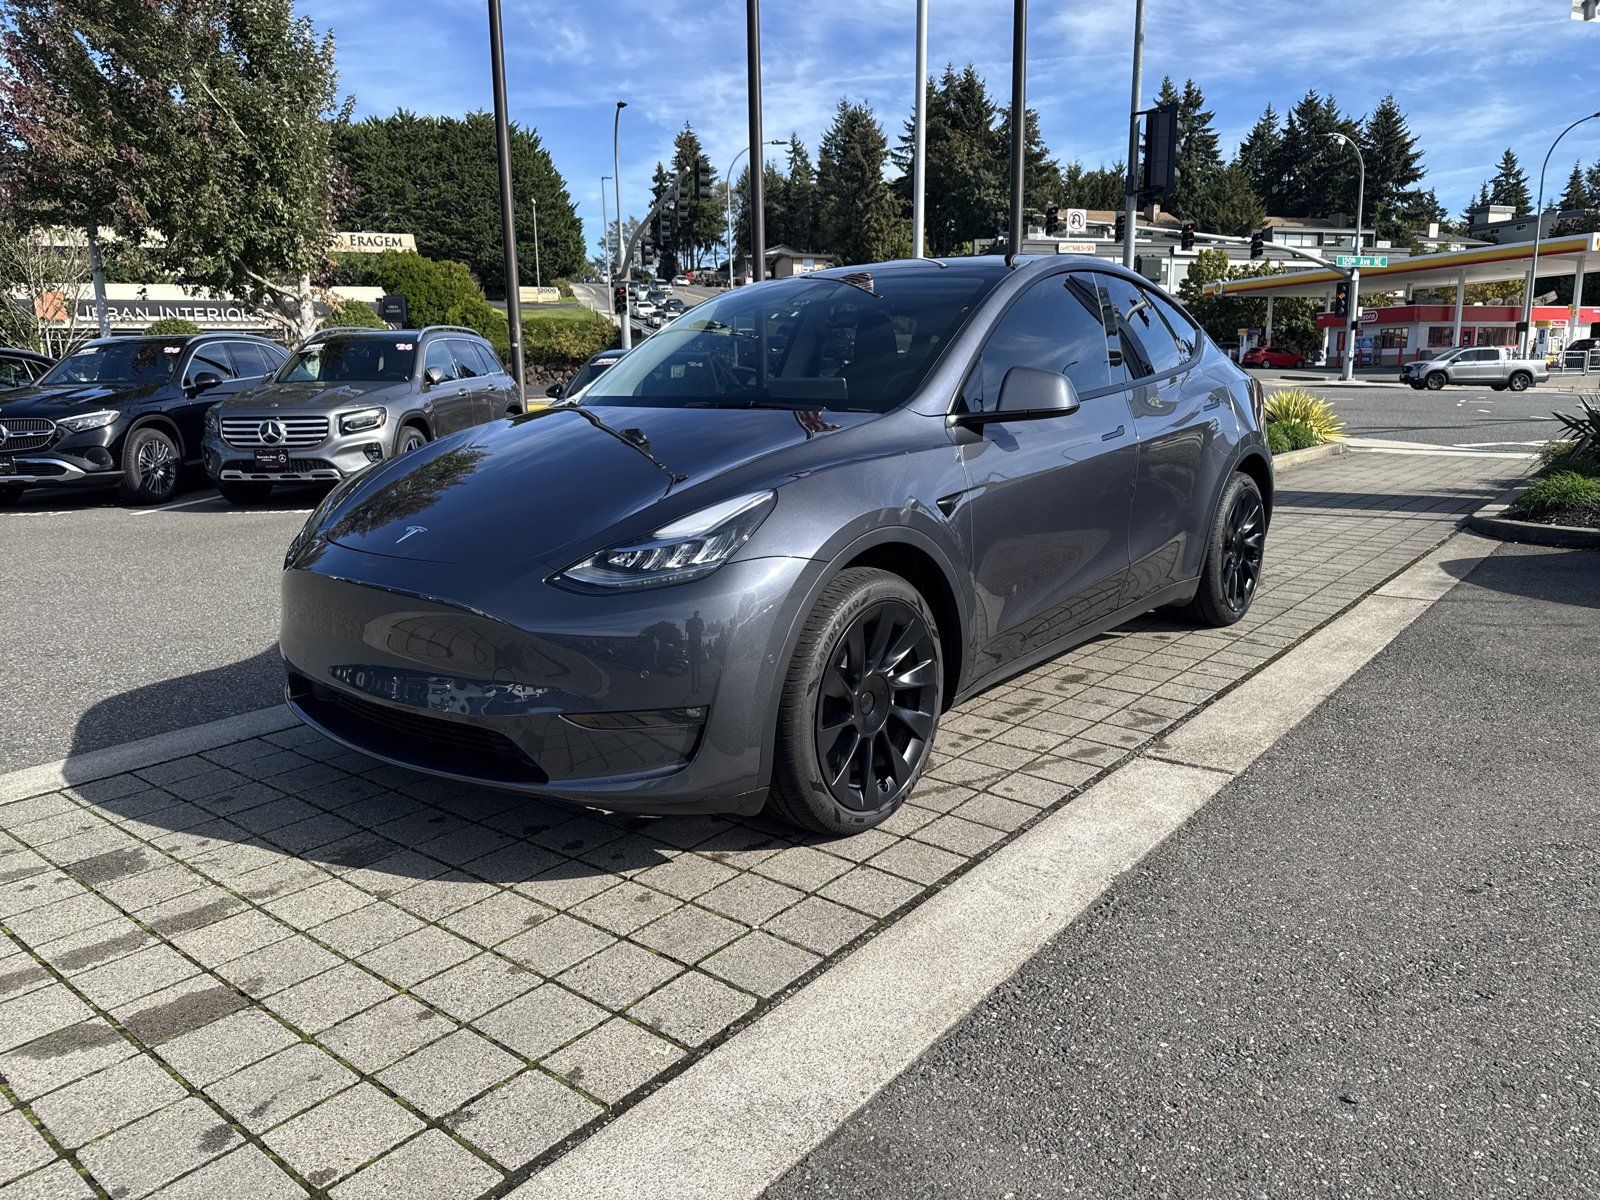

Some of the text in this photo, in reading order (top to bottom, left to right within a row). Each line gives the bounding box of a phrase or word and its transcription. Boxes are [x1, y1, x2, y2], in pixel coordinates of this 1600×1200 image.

[349, 234, 403, 247] ERAGEM
[1360, 257, 1370, 266] Ave
[1374, 257, 1382, 266] NE
[815, 599, 859, 671] GOODYEAR
